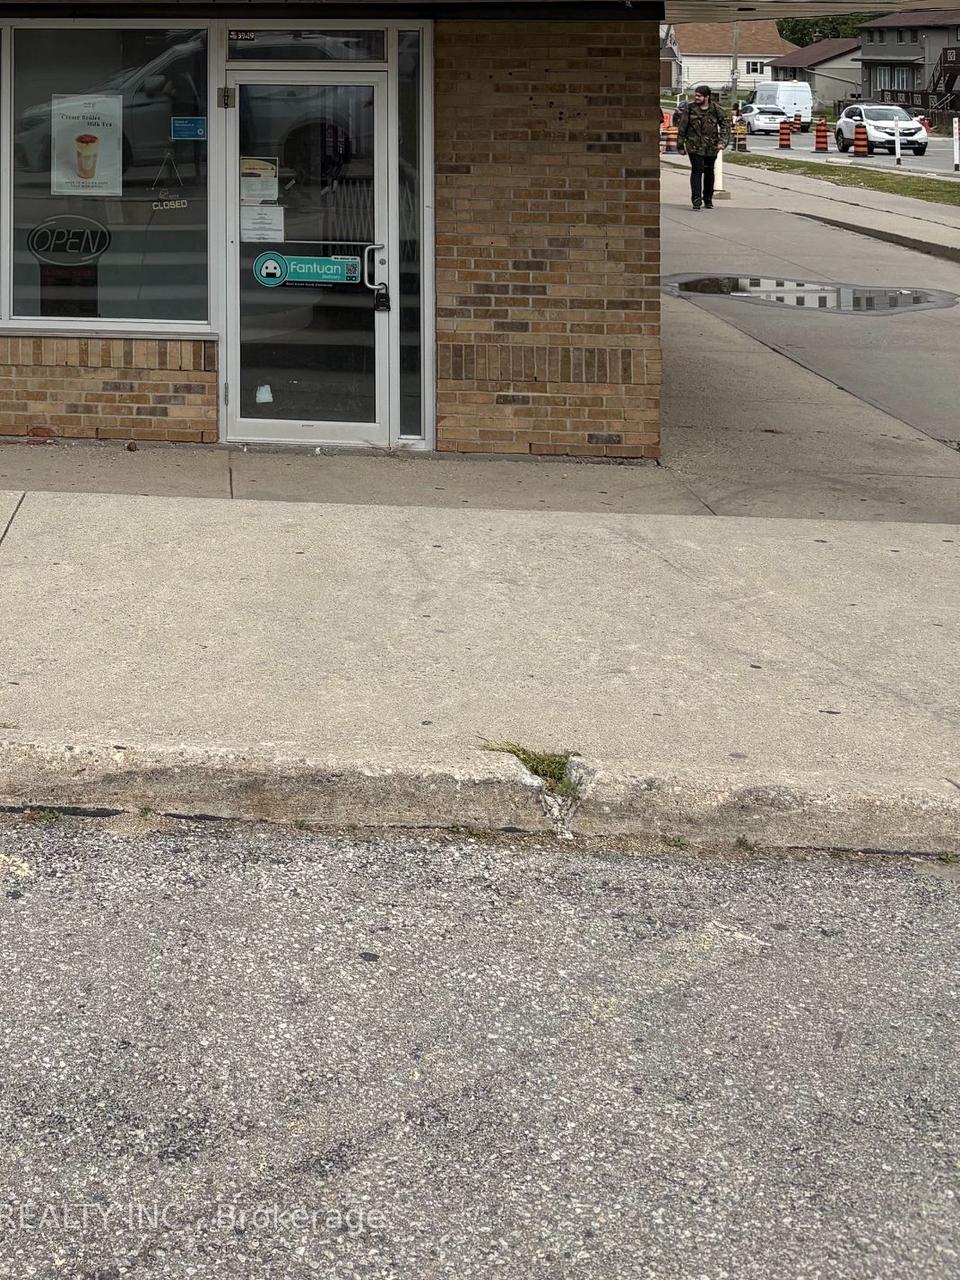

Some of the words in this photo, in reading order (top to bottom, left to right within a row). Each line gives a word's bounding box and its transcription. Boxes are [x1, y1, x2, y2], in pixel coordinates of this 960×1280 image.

[152, 199, 188, 211] CLOSED
[33, 228, 102, 253] OPEN
[290, 261, 342, 274] Fantuan
